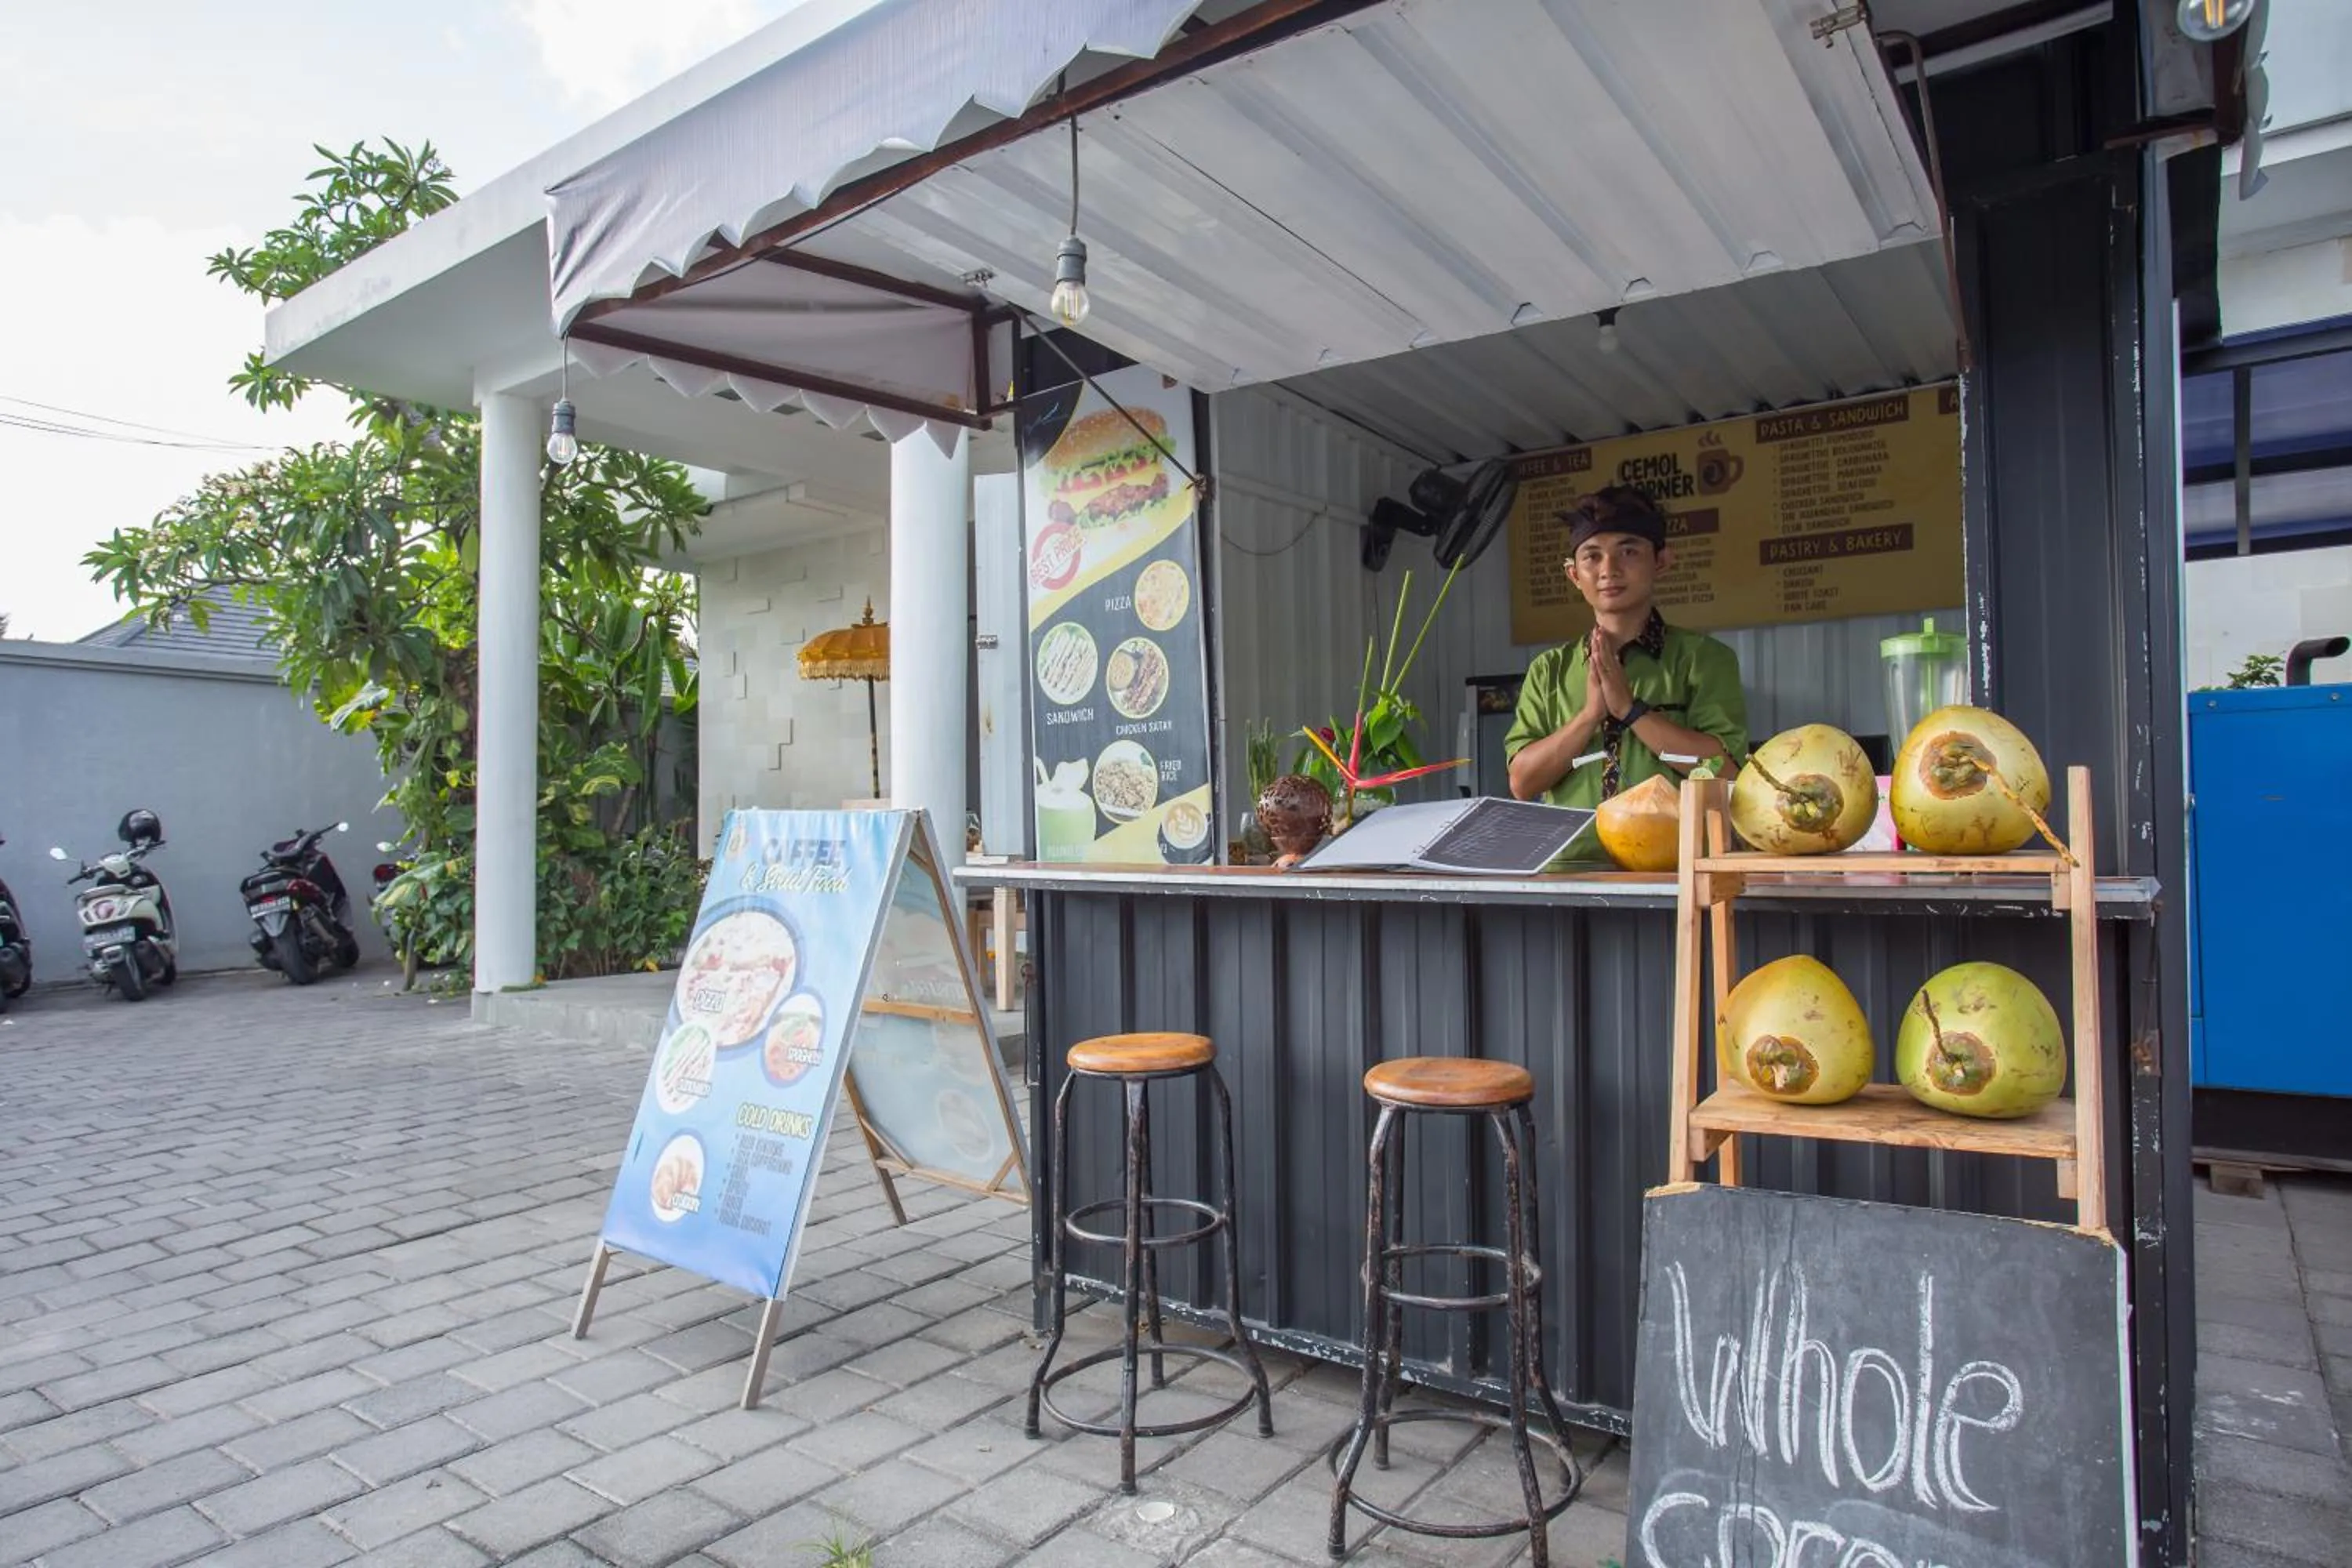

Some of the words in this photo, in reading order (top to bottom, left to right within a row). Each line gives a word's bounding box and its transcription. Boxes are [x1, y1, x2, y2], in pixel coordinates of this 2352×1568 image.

[1760, 419, 1804, 437] PASTA
[1811, 416, 1822, 430] &
[1828, 402, 1904, 427] SANDWICH
[1568, 451, 1588, 471] TEA
[1621, 452, 1682, 481] CEMOL
[1769, 540, 1820, 560] PASTRY
[1830, 539, 1838, 552] &
[1846, 530, 1903, 551] BAKERY
[1105, 595, 1132, 612] PIZZA
[1046, 708, 1094, 725] SANDWICH
[1116, 723, 1147, 735] CHICKEN
[737, 1102, 768, 1129] COLD
[768, 1108, 813, 1139] DRINKS
[1665, 1261, 2023, 1512] Whole
